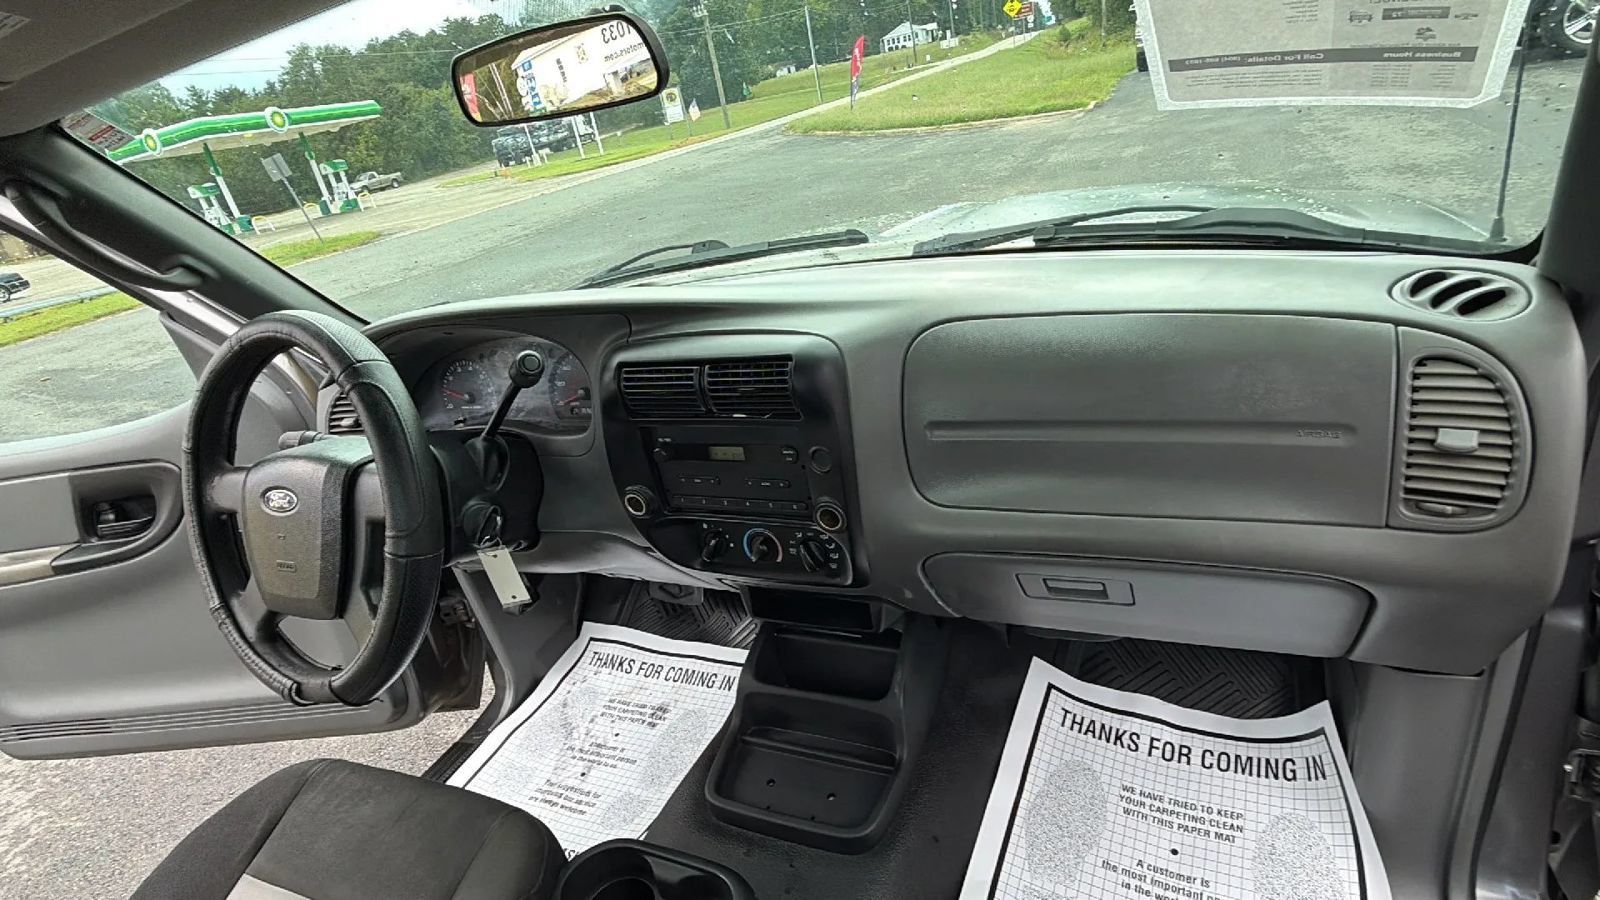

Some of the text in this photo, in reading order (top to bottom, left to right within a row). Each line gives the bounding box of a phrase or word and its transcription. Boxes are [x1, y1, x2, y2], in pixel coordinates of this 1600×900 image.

[588, 651, 737, 693] THANKS FOR COMING IN
[1059, 706, 1328, 783] THANKS FOR COMING IN
[1119, 793, 1244, 833] YOUR CARPETING CLEAN
[1121, 783, 1244, 821] WE HAVE TRIED TO KEEP
[1122, 806, 1237, 844] WITH THIS PAPER MAT
[1102, 859, 1204, 900] the most important
[1121, 881, 1131, 890] in
[1134, 884, 1151, 898] the
[1135, 859, 1211, 888] A customer is
